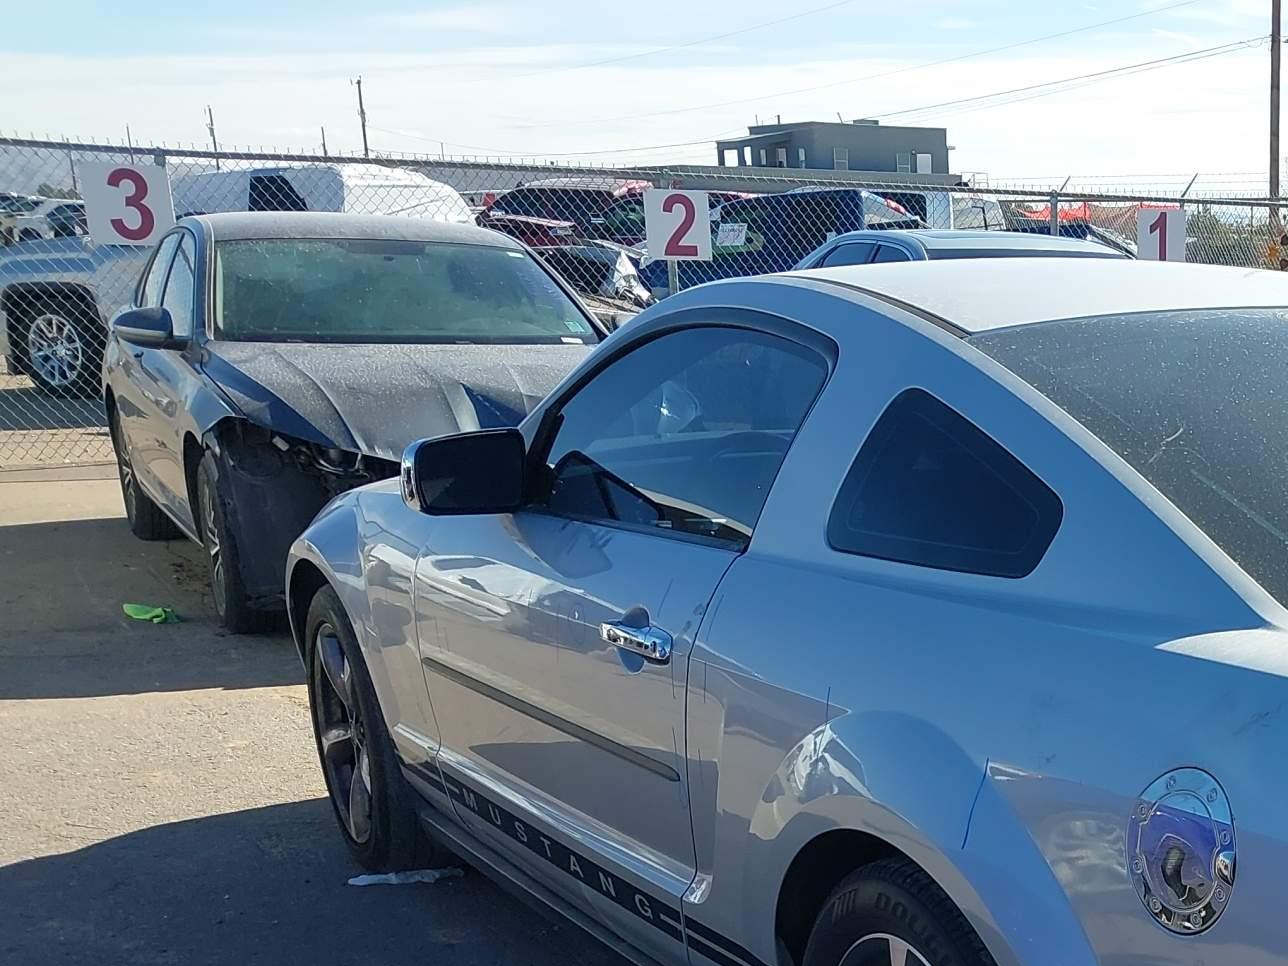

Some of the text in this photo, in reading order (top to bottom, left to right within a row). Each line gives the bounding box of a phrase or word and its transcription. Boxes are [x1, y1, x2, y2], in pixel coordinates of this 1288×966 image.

[107, 167, 155, 241] 3
[662, 193, 699, 257] 2
[1149, 211, 1168, 262] 1
[461, 787, 655, 920] MUSTANG
